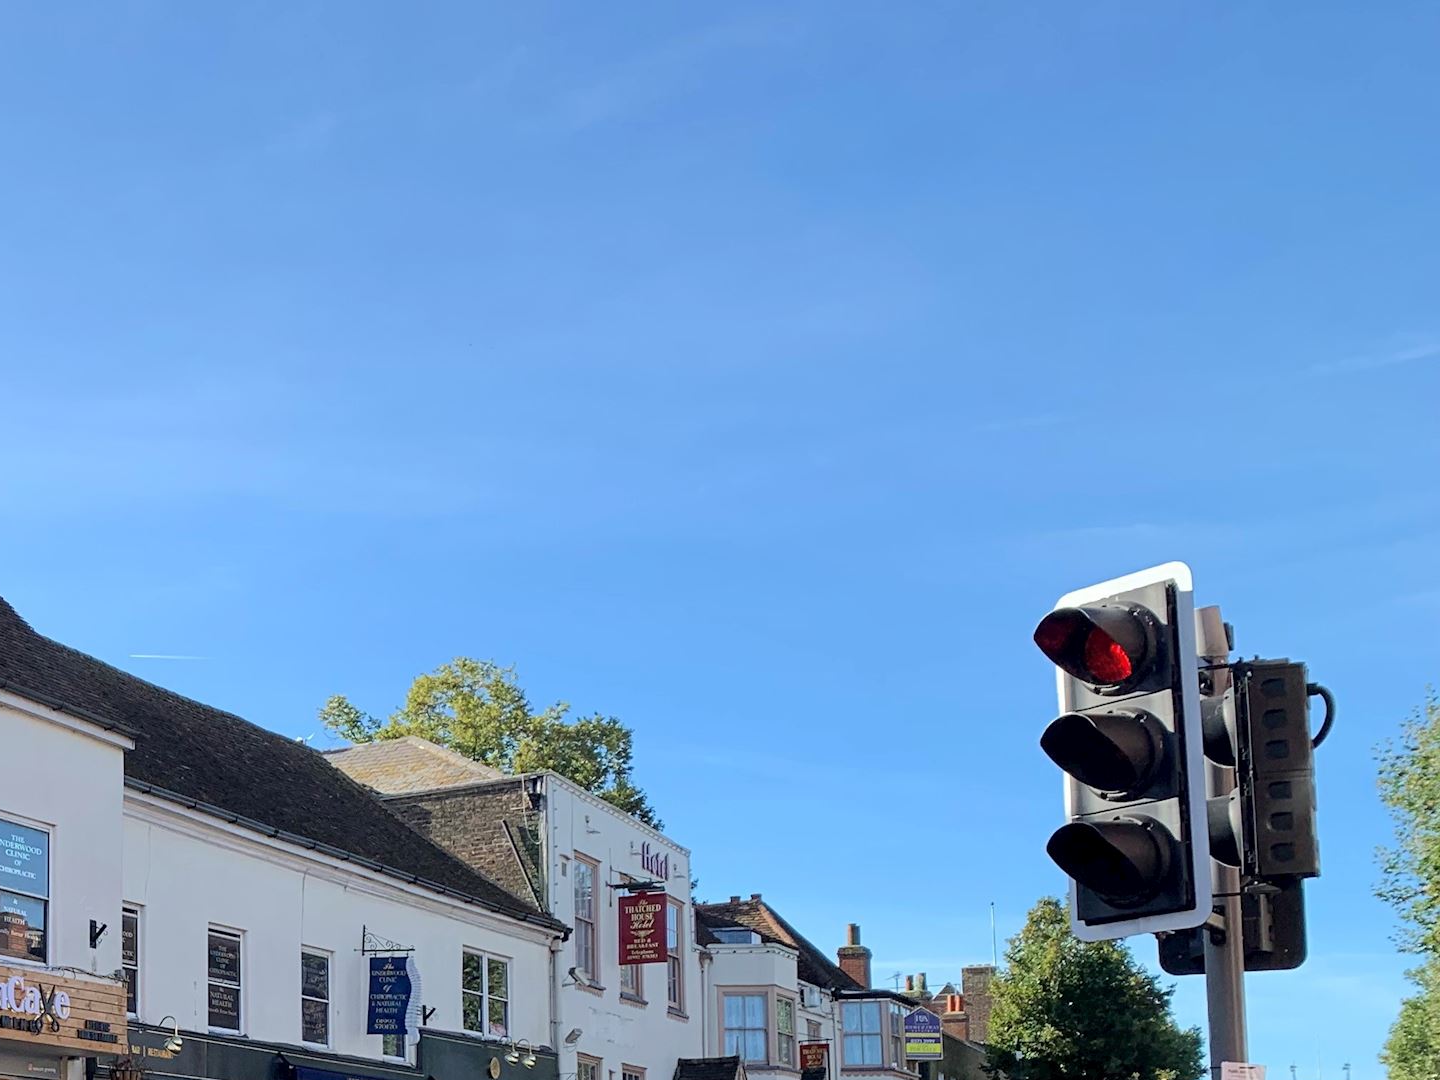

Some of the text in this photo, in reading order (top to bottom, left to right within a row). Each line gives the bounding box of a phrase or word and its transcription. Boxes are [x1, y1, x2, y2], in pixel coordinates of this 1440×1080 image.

[11, 834, 25, 844] THE
[5, 848, 31, 861] CLINIC
[642, 841, 669, 881] Hotel
[625, 904, 662, 914] THATCHED
[631, 913, 654, 921] HOUSE
[630, 919, 654, 929] Hotel
